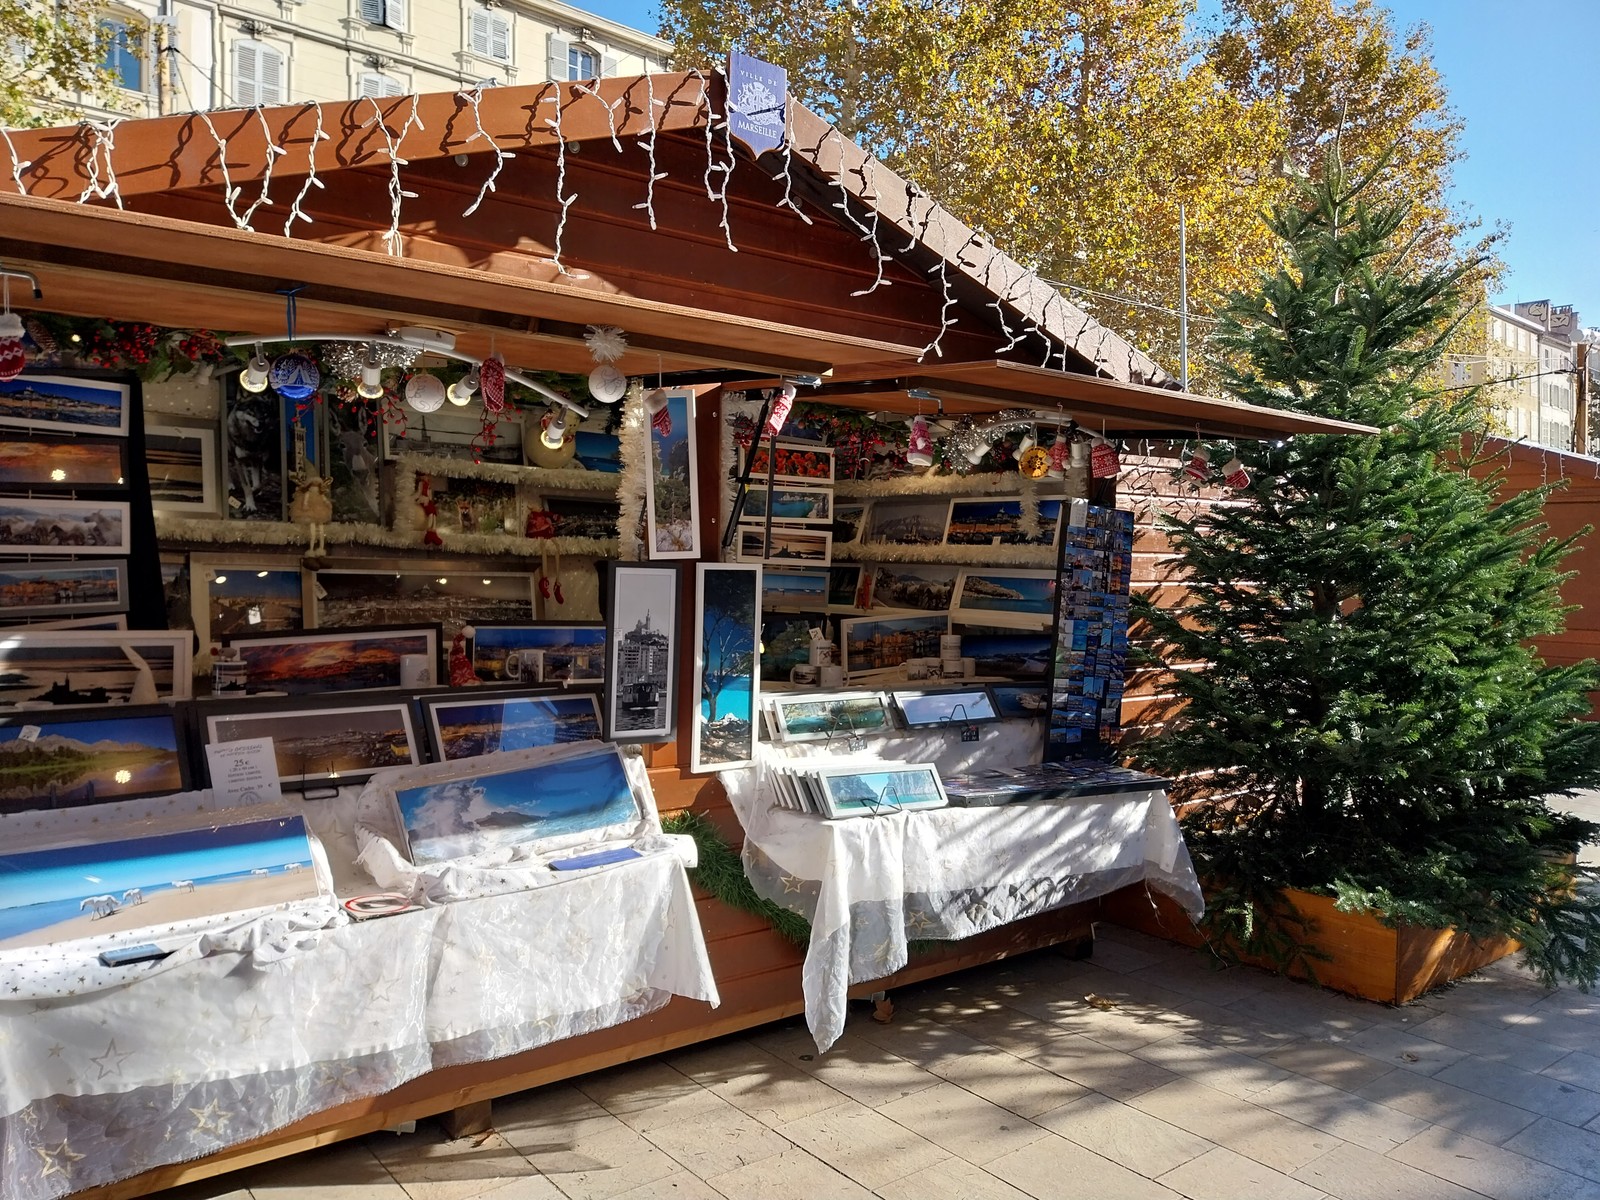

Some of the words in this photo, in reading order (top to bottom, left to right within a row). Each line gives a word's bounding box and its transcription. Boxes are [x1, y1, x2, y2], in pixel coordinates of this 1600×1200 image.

[740, 70, 763, 82] VILLE
[768, 78, 777, 86] DE
[738, 120, 777, 139] MARSEILLE
